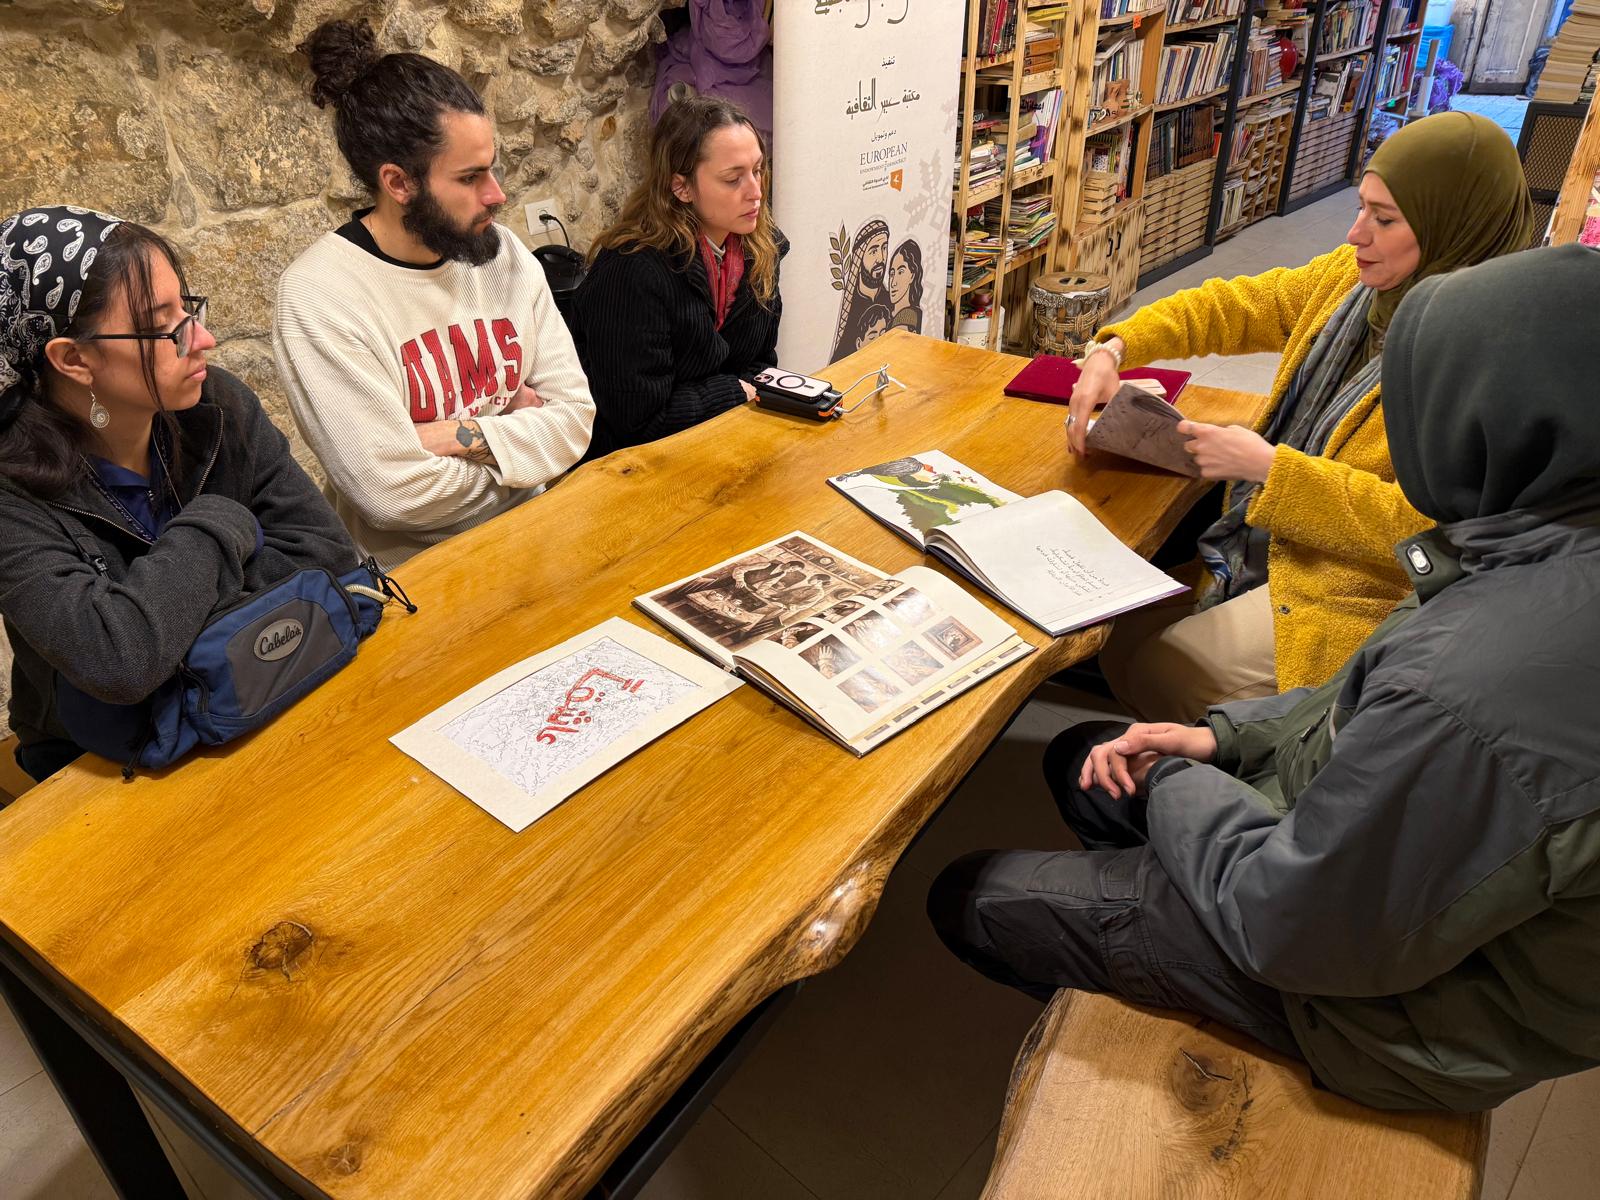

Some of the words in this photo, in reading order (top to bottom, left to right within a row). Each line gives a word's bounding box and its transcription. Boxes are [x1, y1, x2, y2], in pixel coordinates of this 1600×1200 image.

[846, 77, 877, 120] الثقافية
[902, 89, 921, 109] مكتبة
[860, 142, 908, 166] EUROPEAN
